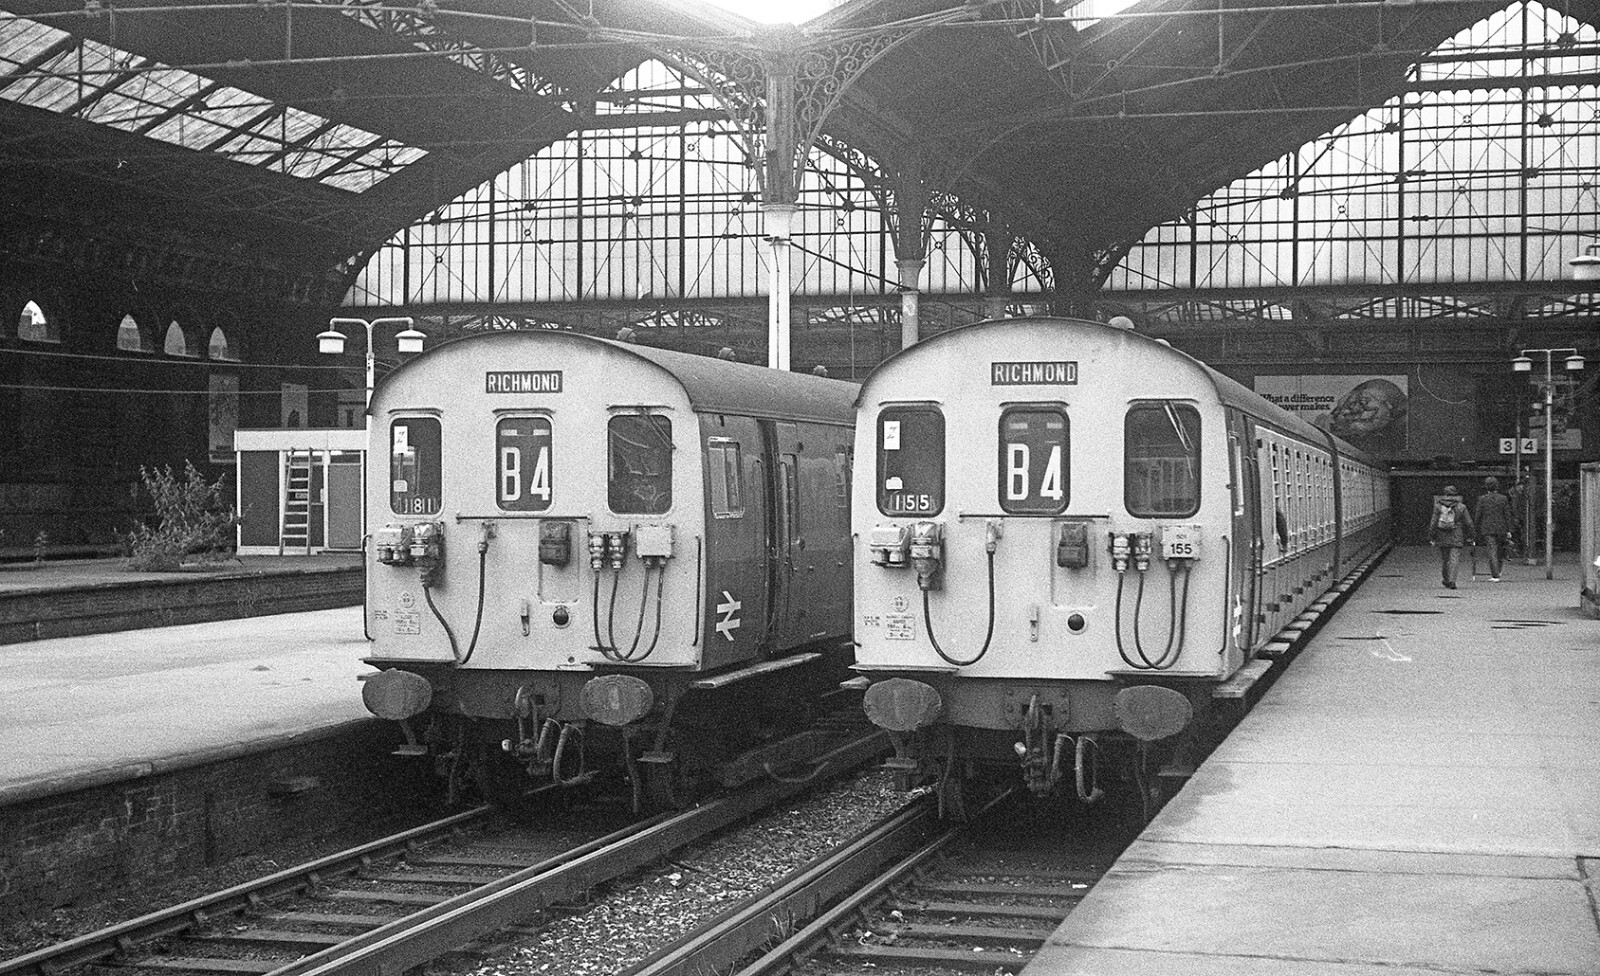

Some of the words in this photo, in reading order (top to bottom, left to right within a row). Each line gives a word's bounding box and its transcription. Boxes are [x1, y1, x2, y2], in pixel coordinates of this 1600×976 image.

[995, 364, 1076, 382] RICHMOND
[488, 374, 559, 391] RICHMOND
[1290, 394, 1335, 403] difference
[1503, 441, 1513, 452] 3
[1524, 440, 1534, 452] 4
[1170, 543, 1192, 554] 155
